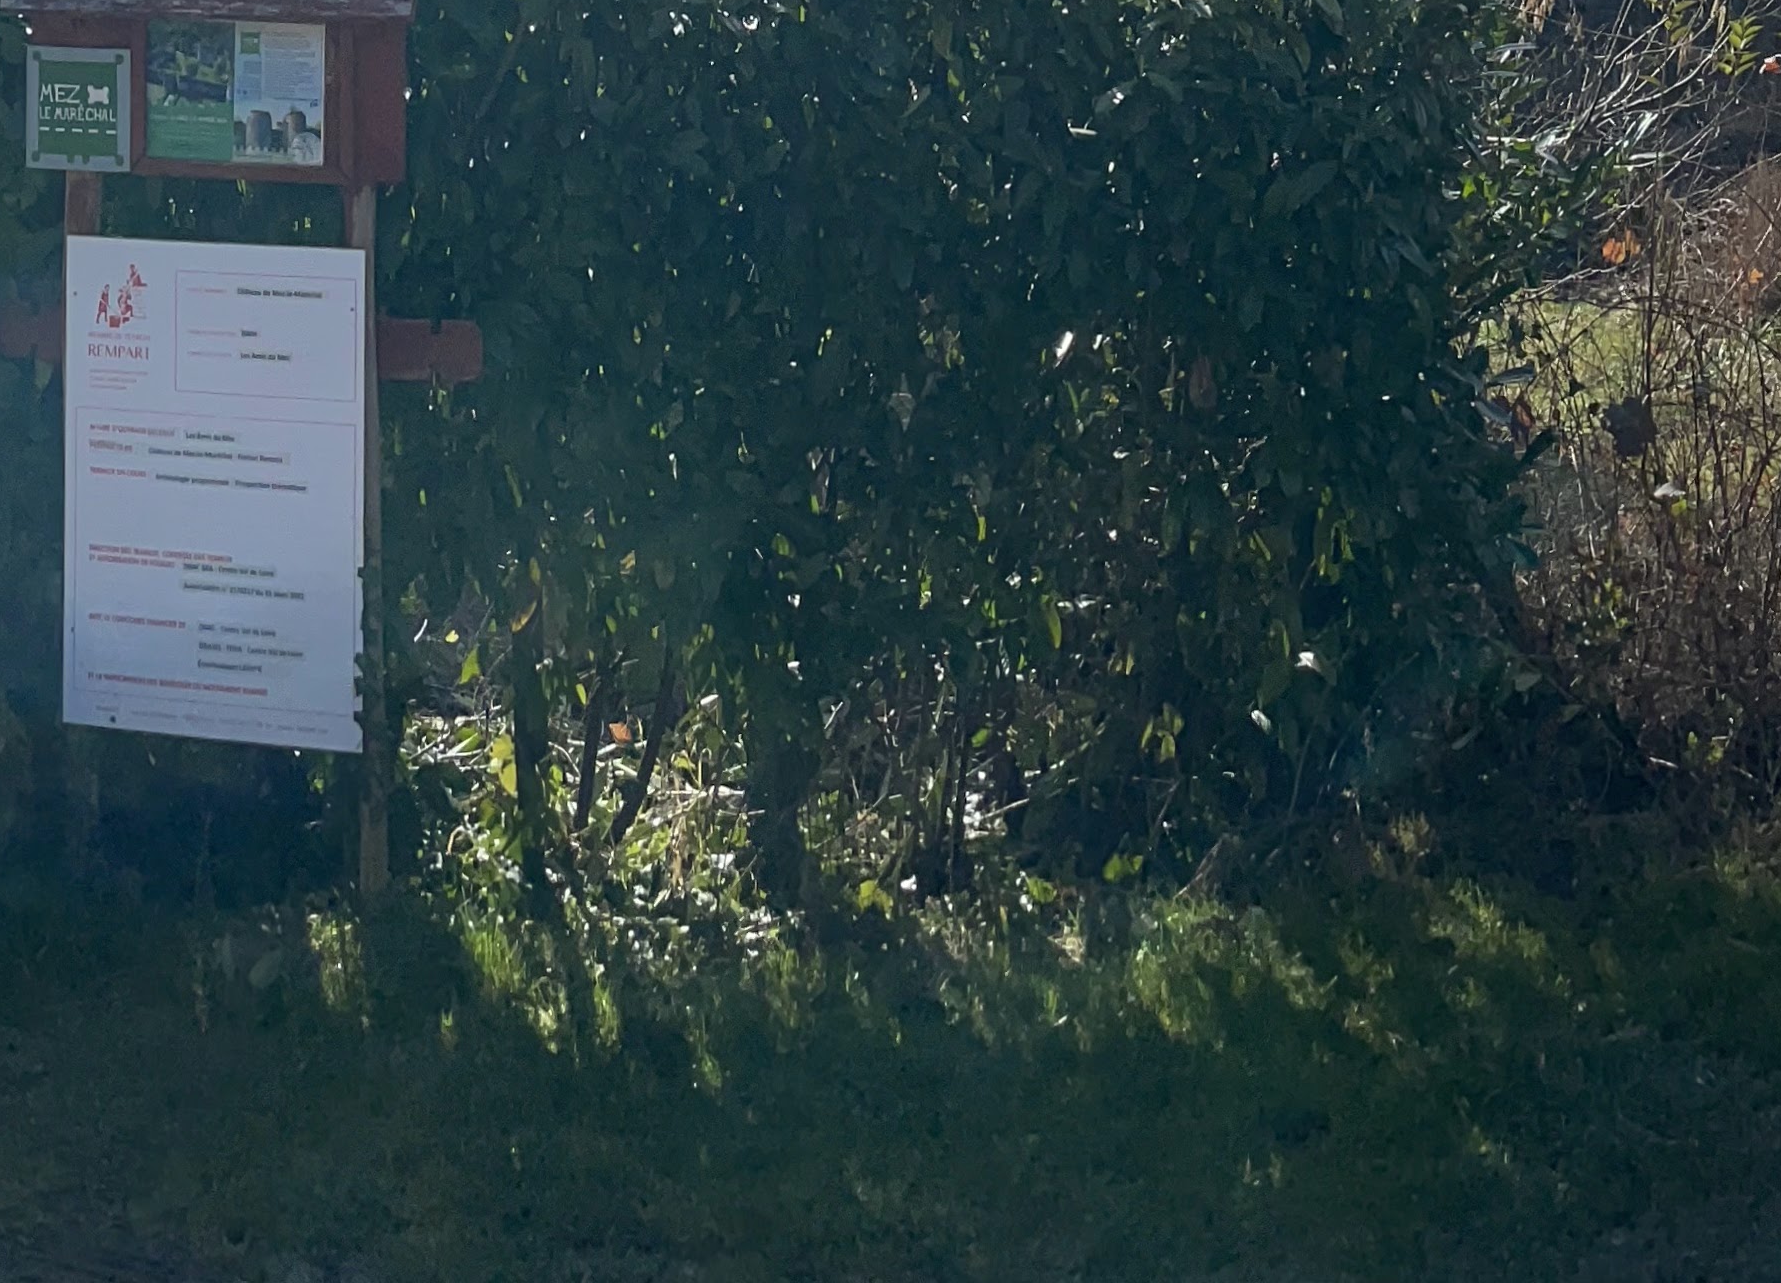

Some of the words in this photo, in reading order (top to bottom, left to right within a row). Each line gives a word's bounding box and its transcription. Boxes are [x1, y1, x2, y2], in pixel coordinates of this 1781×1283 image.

[40, 83, 80, 104] MEZ
[39, 106, 51, 120] LE
[88, 343, 150, 360] REMPART
